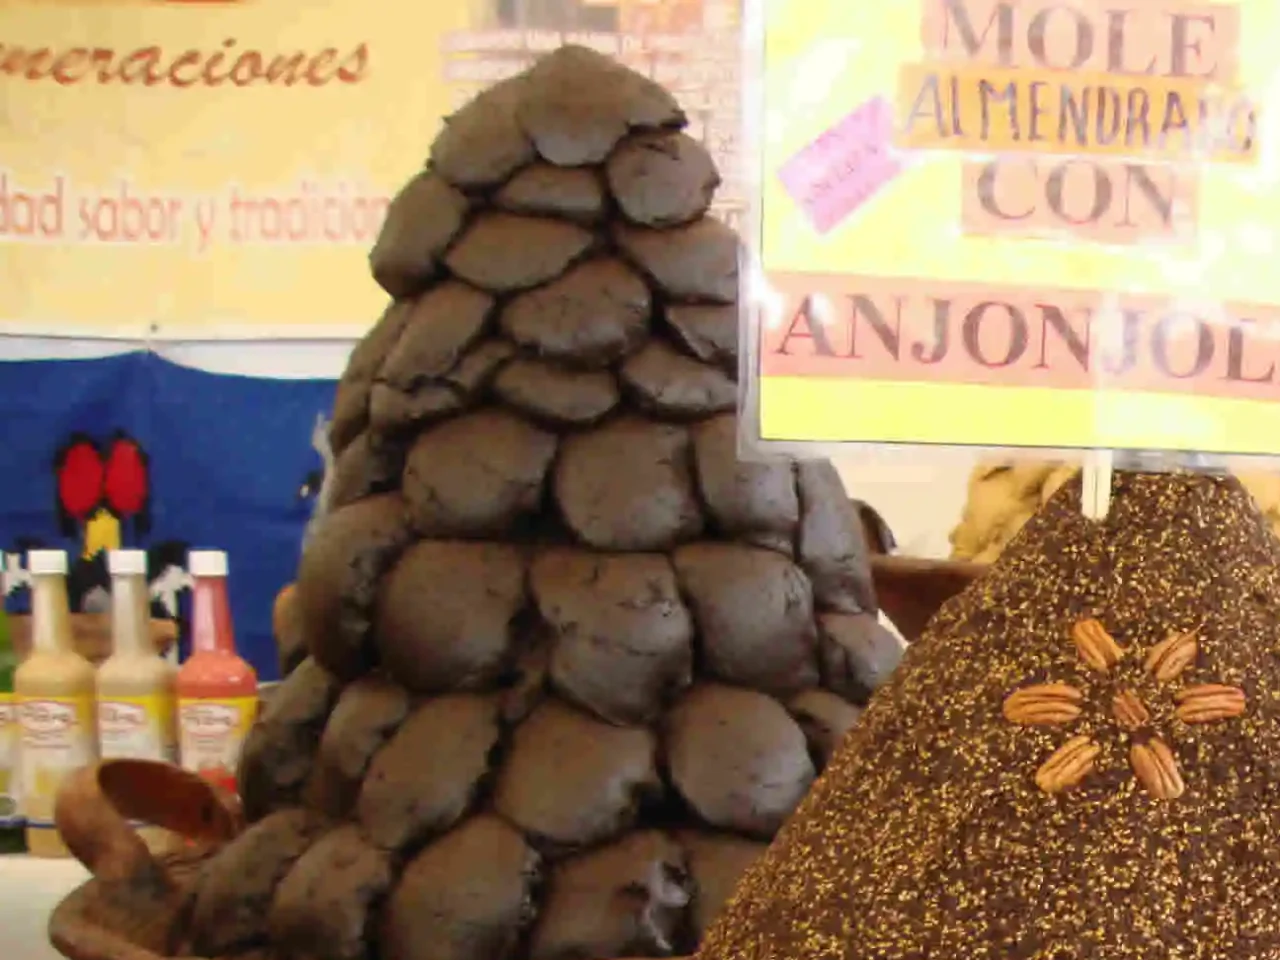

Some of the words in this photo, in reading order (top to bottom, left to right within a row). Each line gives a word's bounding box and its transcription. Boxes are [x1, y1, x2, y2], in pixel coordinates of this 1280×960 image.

[938, 0, 1218, 79] MOLE
[903, 73, 1258, 153] ALMENDRAO
[78, 180, 182, 241] sabor
[196, 198, 215, 252] y
[976, 158, 1176, 228] CON
